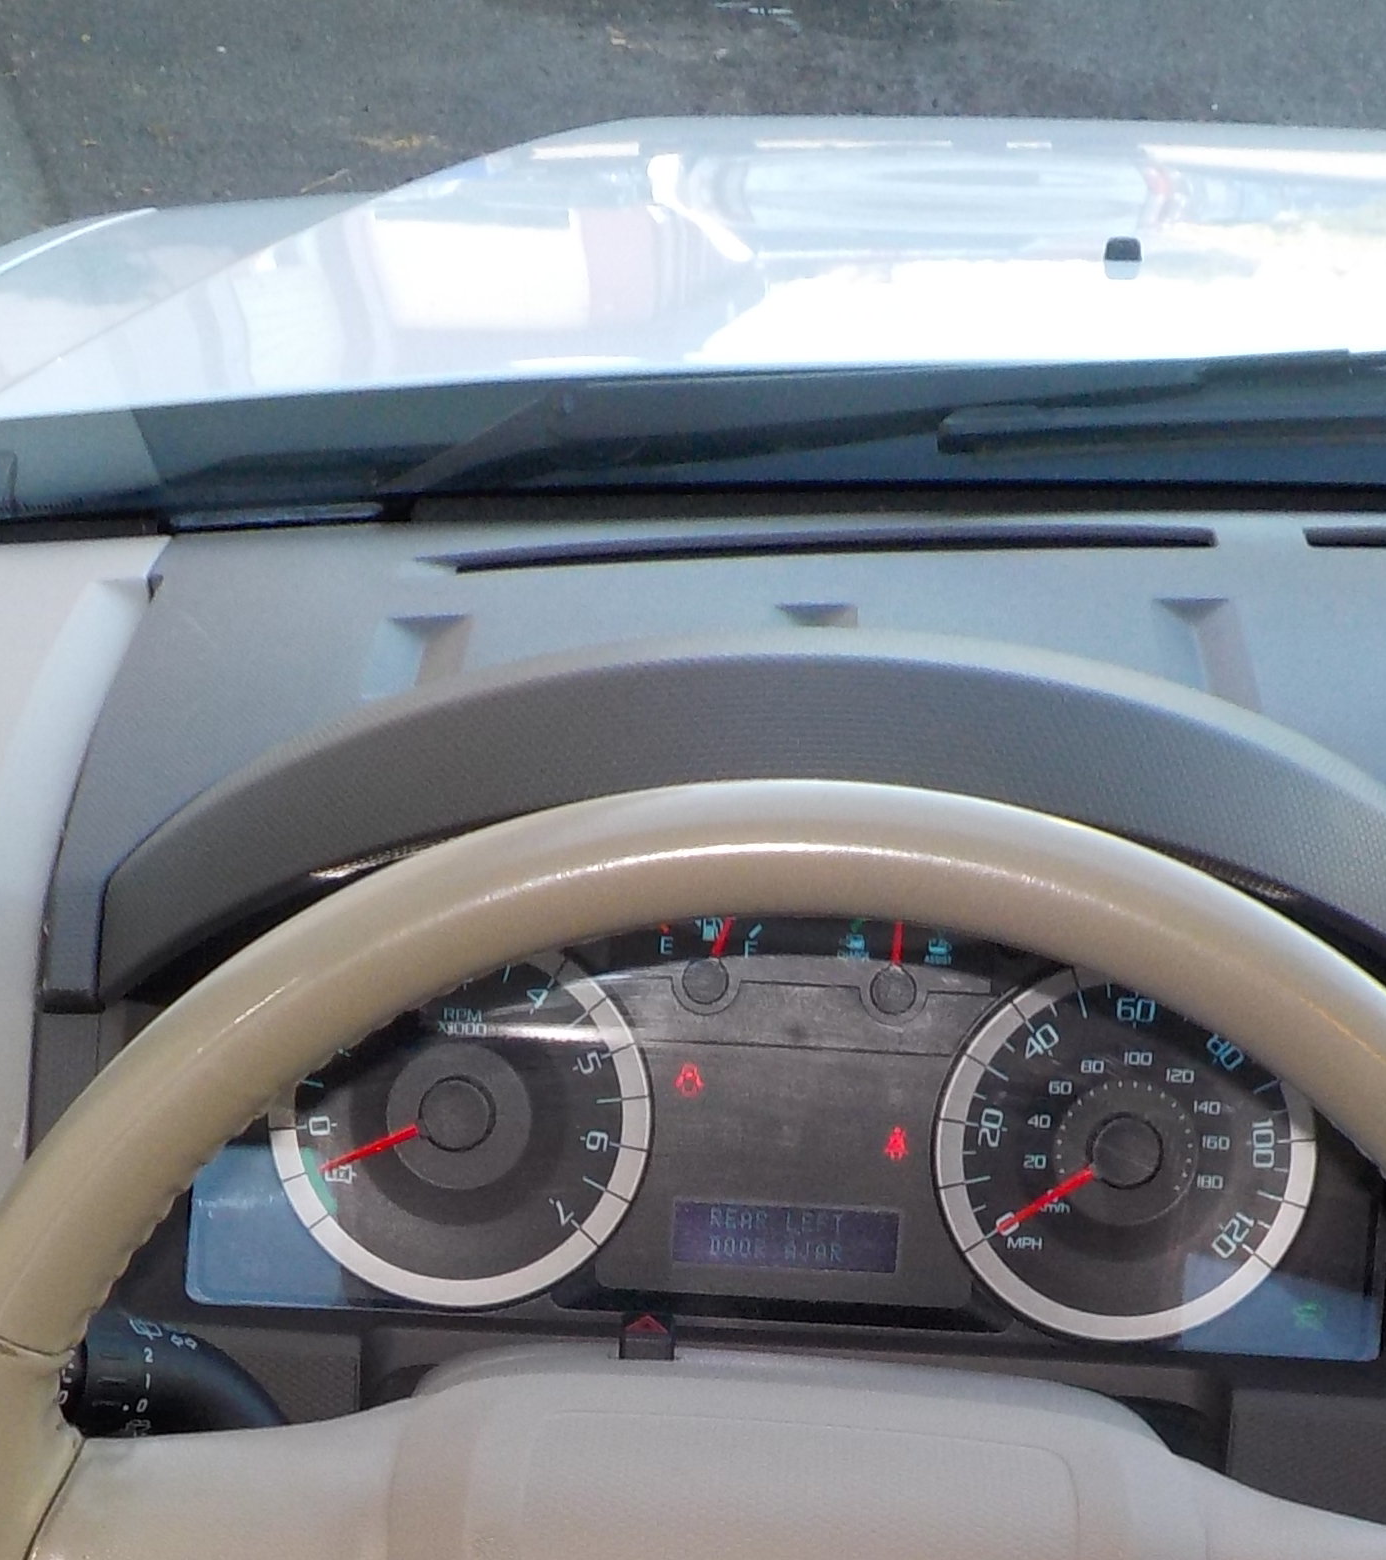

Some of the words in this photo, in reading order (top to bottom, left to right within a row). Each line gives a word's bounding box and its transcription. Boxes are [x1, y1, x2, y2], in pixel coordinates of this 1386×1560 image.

[661, 936, 674, 955] E
[744, 940, 758, 958] F
[525, 987, 550, 1009] 4
[442, 1007, 483, 1023] RPM
[1116, 997, 1156, 1023] 60
[1024, 1022, 1059, 1060] 40
[576, 1050, 603, 1076] 5
[1080, 1059, 1105, 1074] 80
[1123, 1051, 1153, 1067] 100
[1165, 1068, 1195, 1084] 120
[1048, 1080, 1073, 1096] 60
[1193, 1100, 1222, 1116] 140
[308, 1115, 331, 1136] 0
[977, 1107, 1004, 1148] 20
[1027, 1113, 1052, 1129] 40
[585, 1130, 609, 1153] 6
[1202, 1134, 1231, 1151] 160
[1251, 1117, 1275, 1169] 100
[1022, 1154, 1047, 1170] 20
[1196, 1174, 1225, 1190] 180
[556, 1200, 576, 1227] 7
[709, 1206, 767, 1230] REAR
[785, 1210, 844, 1233] LEFT
[1006, 1236, 1043, 1250] MPH
[1212, 1211, 1255, 1259] 120
[709, 1234, 767, 1259] DOOR
[783, 1239, 843, 1262] AJAR
[143, 1346, 154, 1363] 2
[145, 1373, 151, 1391] 1
[136, 1398, 148, 1413] 0
